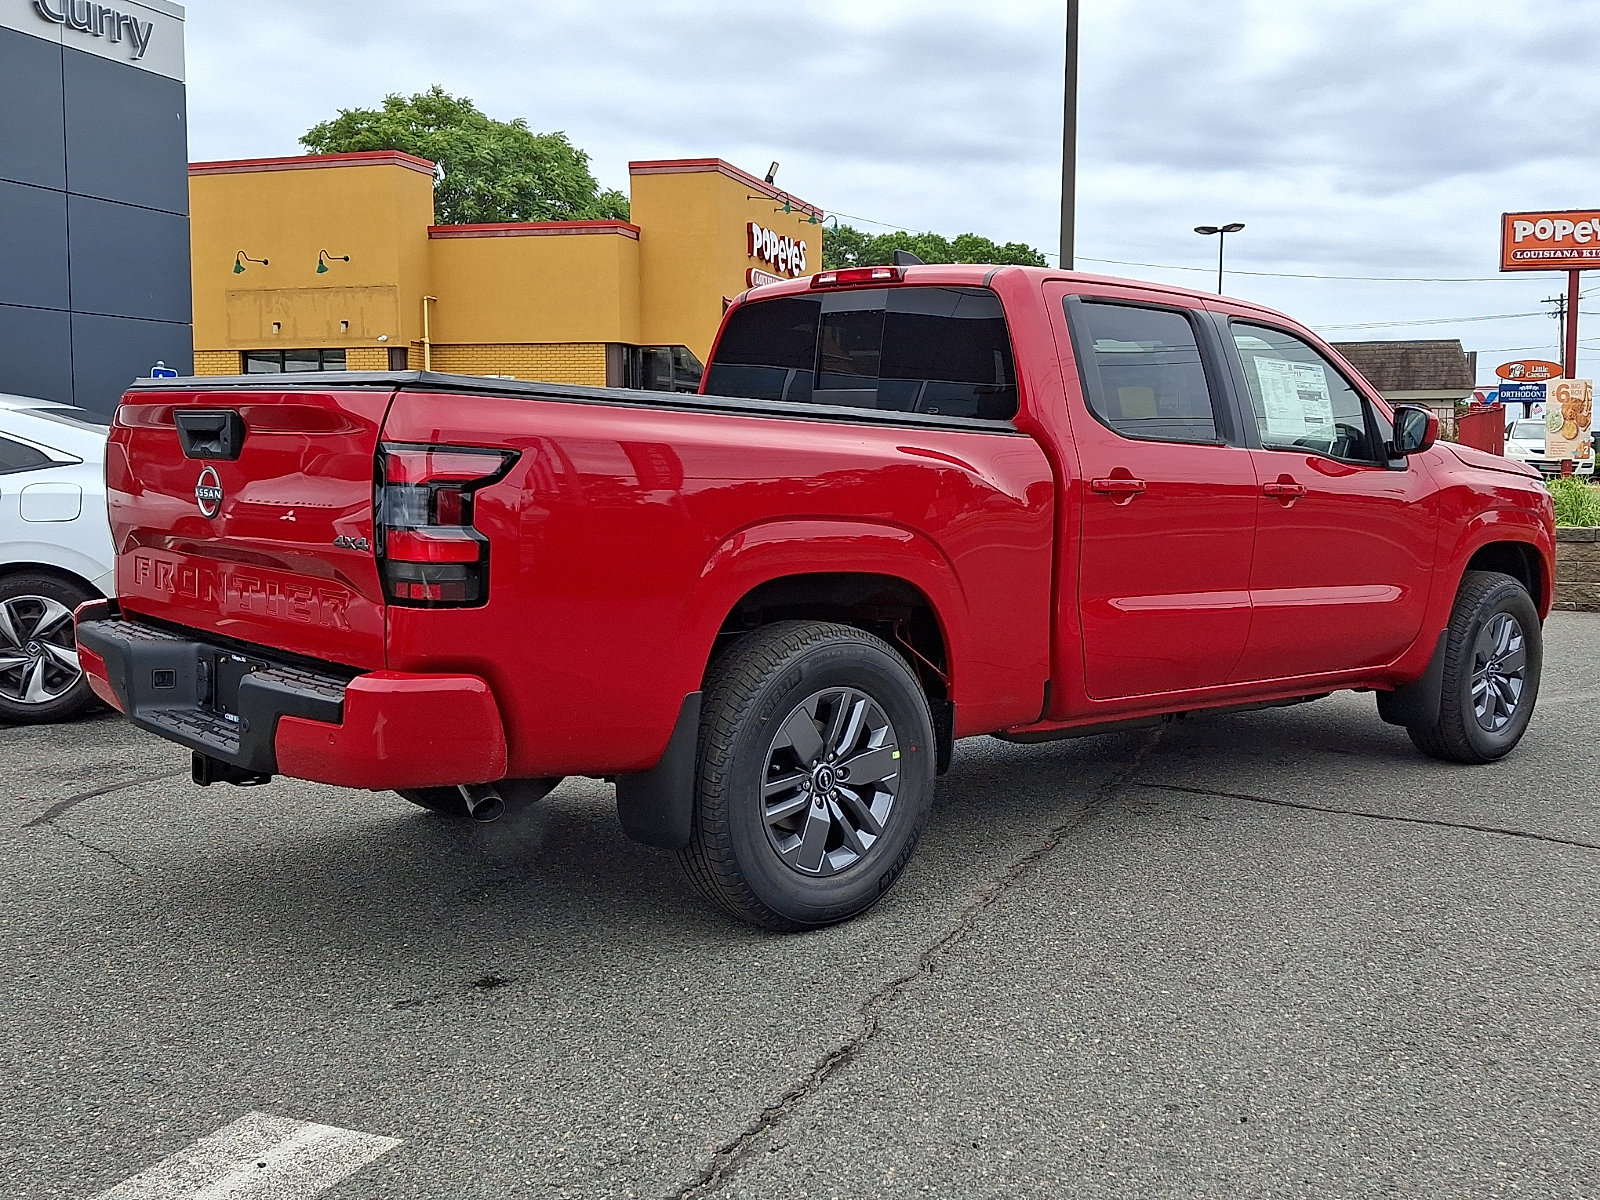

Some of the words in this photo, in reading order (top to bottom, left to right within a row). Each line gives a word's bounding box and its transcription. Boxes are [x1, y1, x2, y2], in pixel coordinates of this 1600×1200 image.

[33, 0, 153, 60] Curry
[1515, 249, 1579, 259] LOUISIANA
[195, 486, 222, 499] SSAN
[134, 555, 350, 632] FRONTIER
